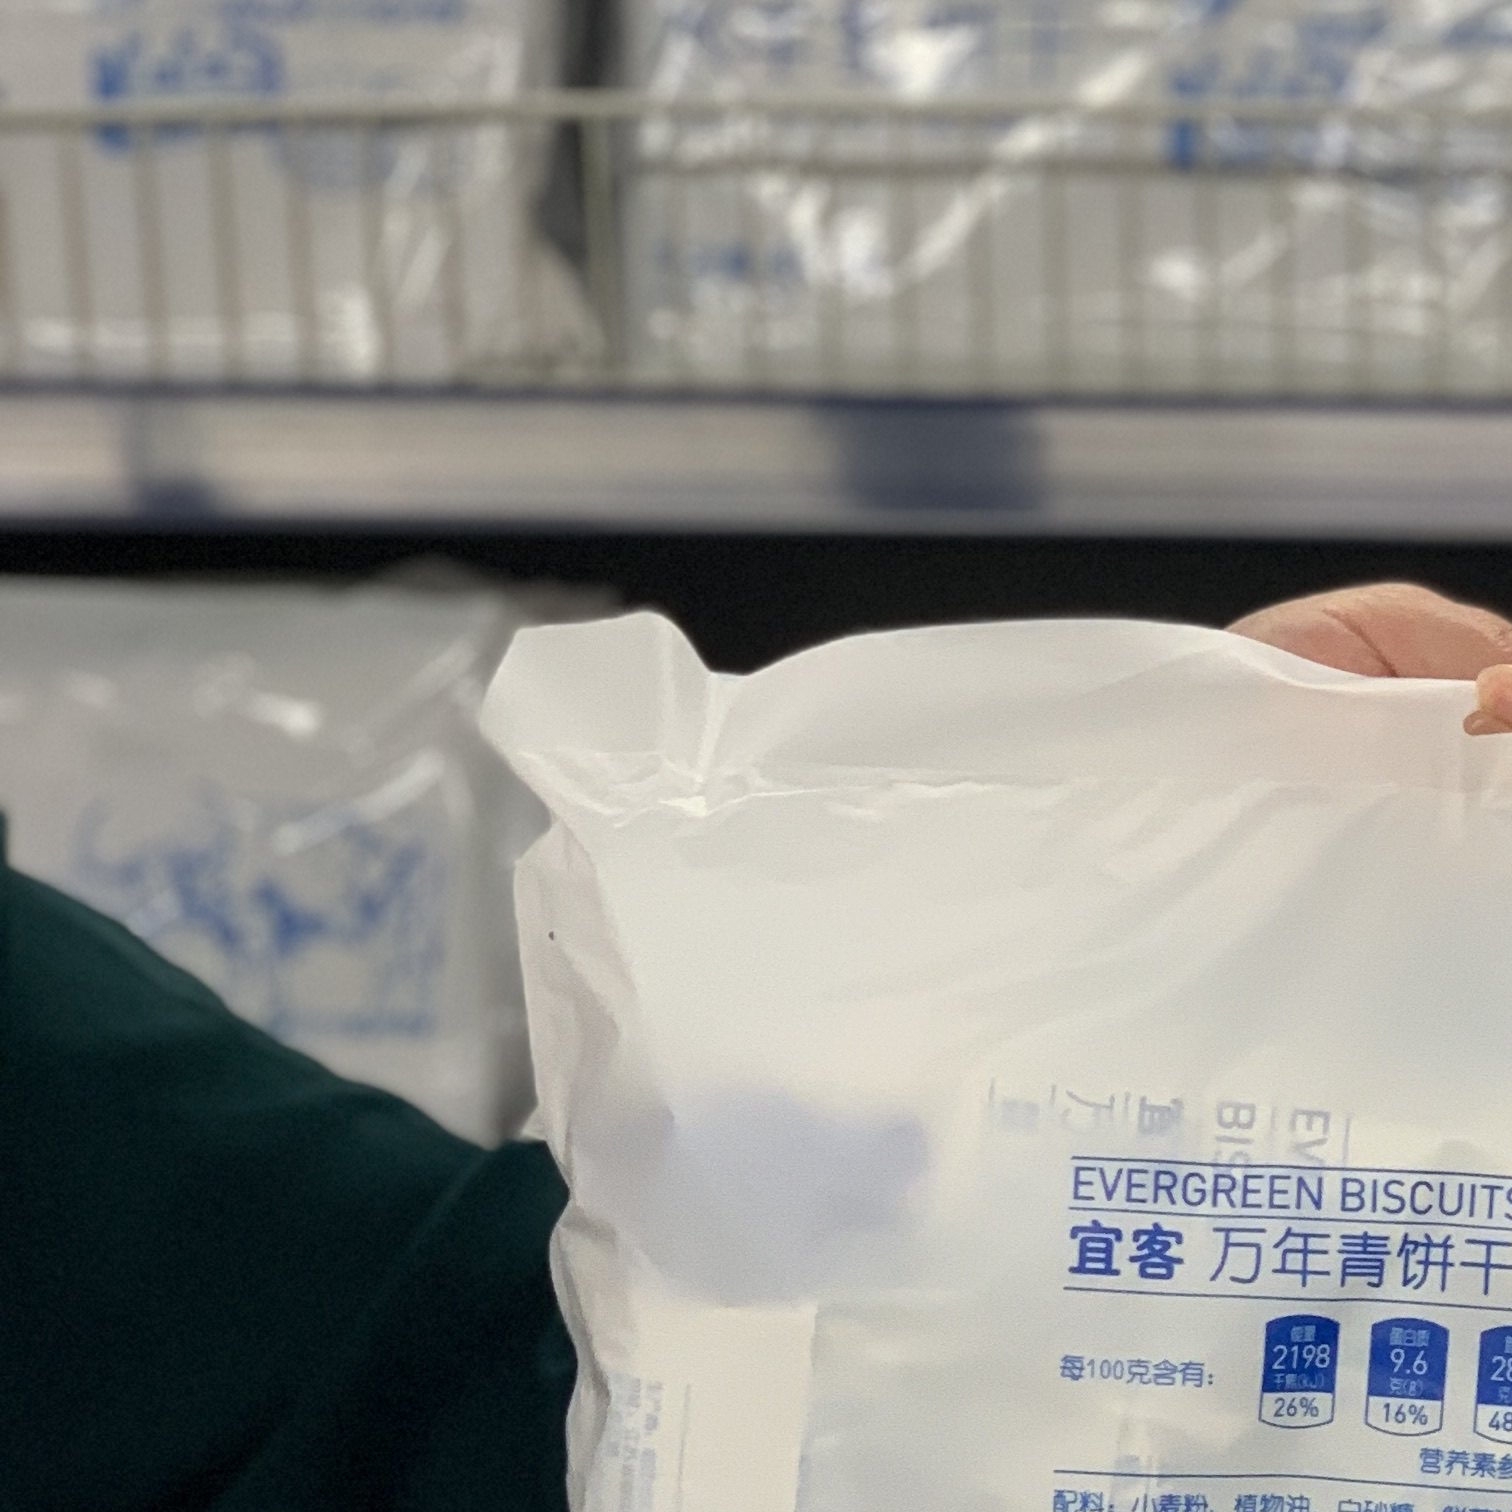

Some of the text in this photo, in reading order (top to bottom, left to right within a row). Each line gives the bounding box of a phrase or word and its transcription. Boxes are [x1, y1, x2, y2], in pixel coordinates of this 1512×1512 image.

[1071, 1165, 1325, 1212] EVERGREEN
[1068, 1219, 1185, 1282] 宜客
[1059, 1353, 1214, 1388] 每100克含有：
[1271, 1344, 1331, 1370] 2198
[1390, 1349, 1429, 1376] 9.6
[1273, 1396, 1320, 1419] 26%
[1382, 1402, 1429, 1427] 16%
